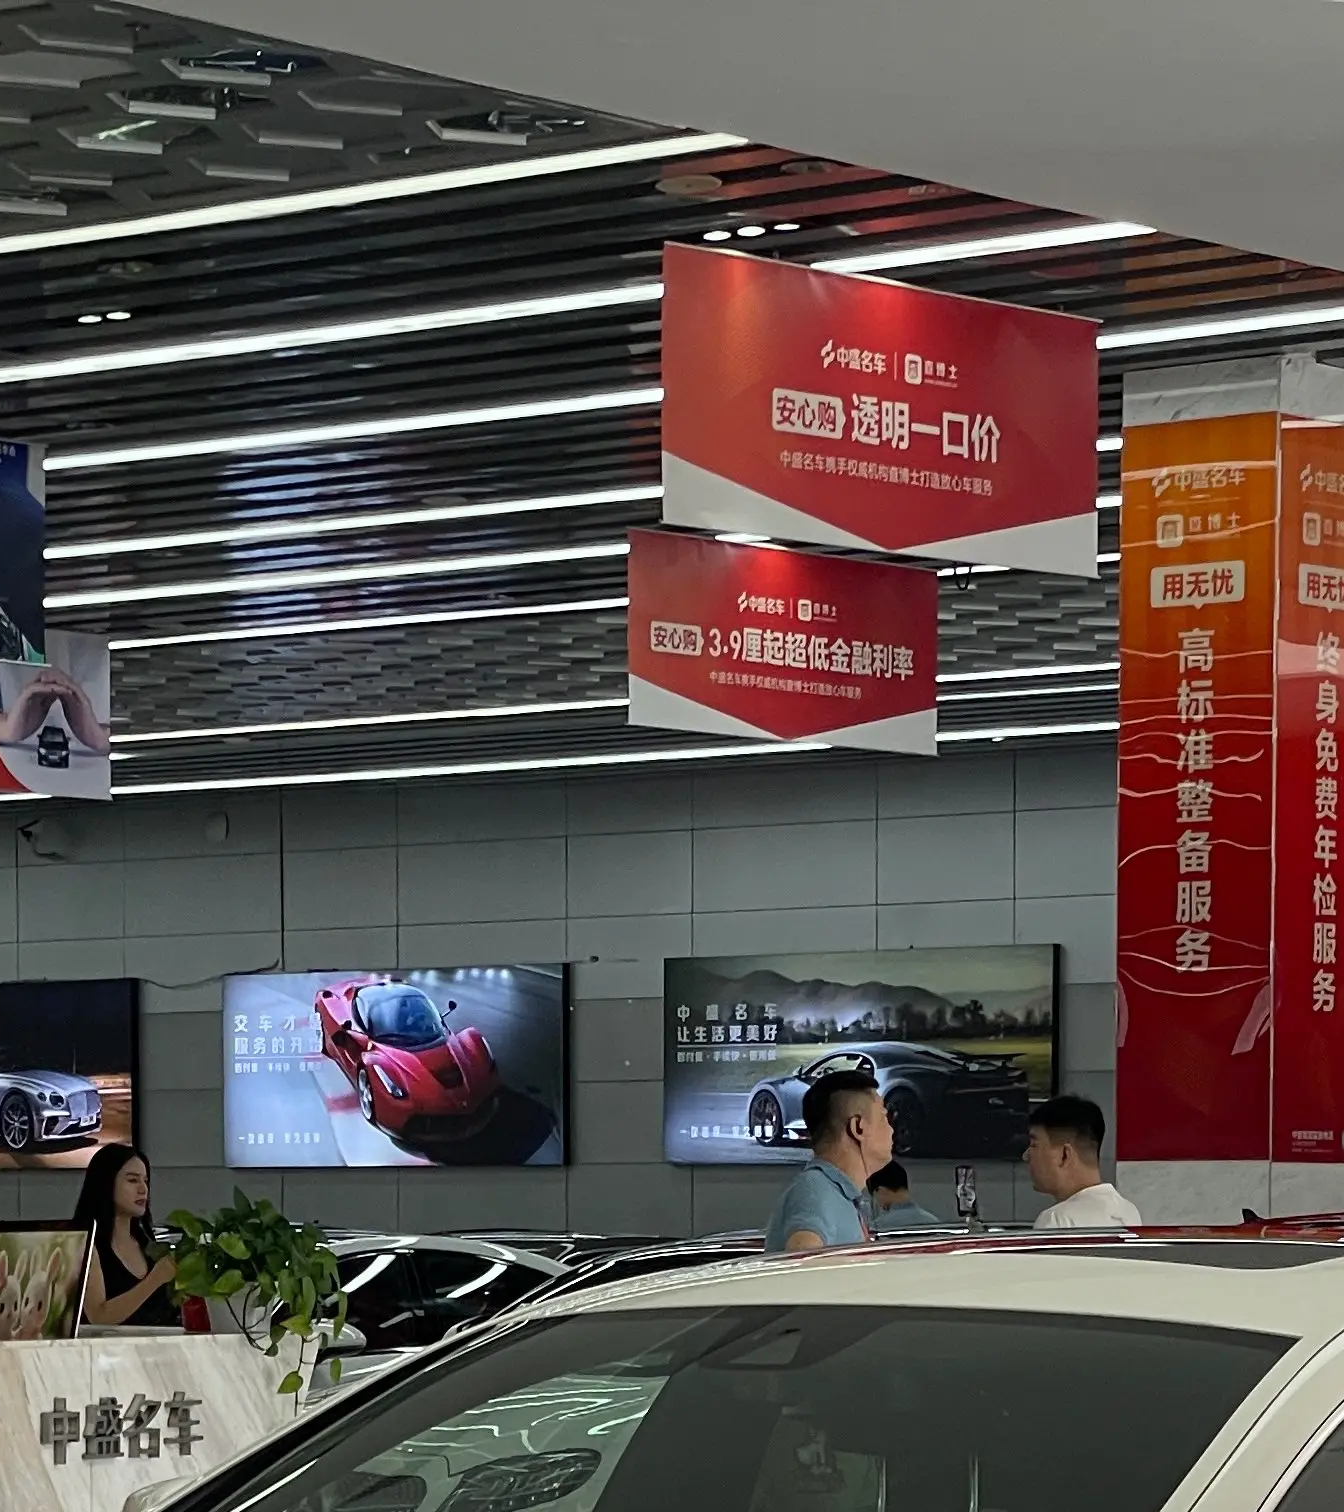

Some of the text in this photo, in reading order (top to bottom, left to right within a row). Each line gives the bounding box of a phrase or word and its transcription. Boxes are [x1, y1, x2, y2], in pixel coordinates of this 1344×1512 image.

[837, 346, 887, 375] 中盛名车
[776, 392, 1001, 464] 安心购 透明一口价
[1174, 465, 1246, 491] 中盛名车
[1162, 568, 1234, 601] 用无忧
[653, 625, 914, 681] 安心购 3.9厘起超低金融利率
[1175, 627, 1216, 974] 高标准整备服务
[1311, 631, 1341, 1013] 终身免费年检服务
[677, 1024, 778, 1042] 让生活更美好
[39, 1390, 204, 1466] 中盛名车
